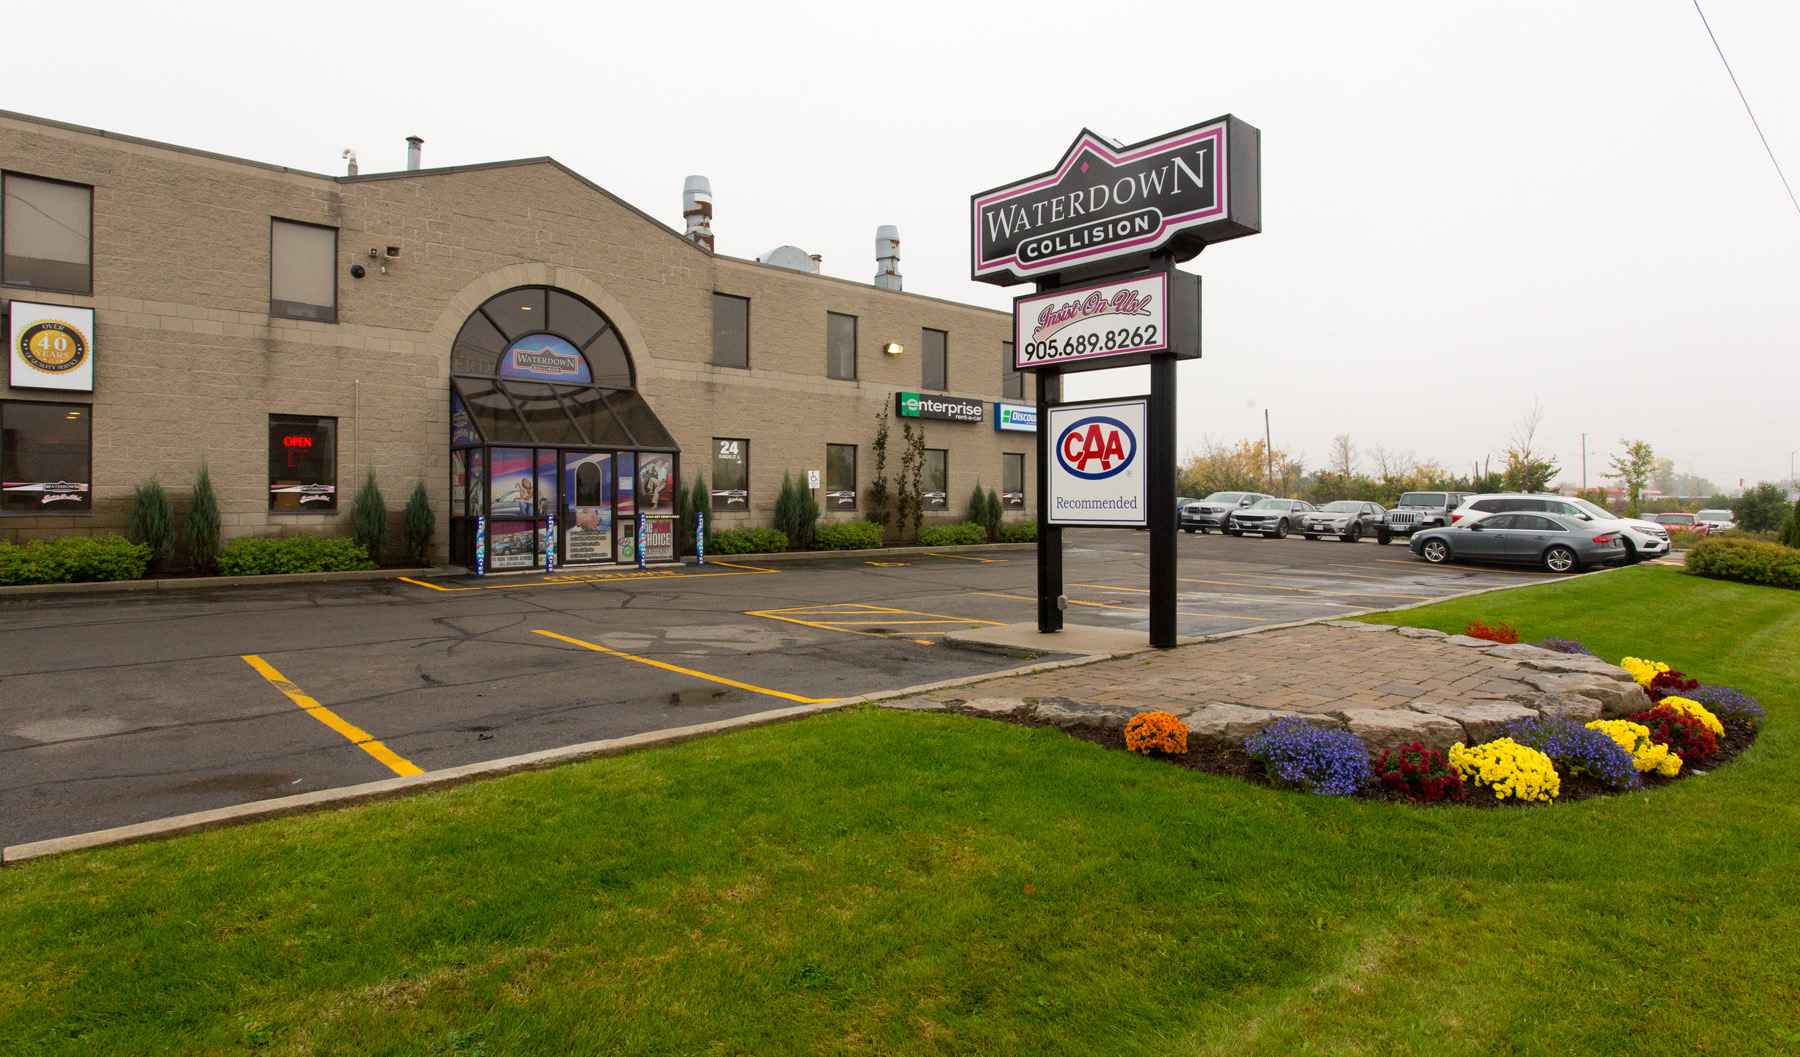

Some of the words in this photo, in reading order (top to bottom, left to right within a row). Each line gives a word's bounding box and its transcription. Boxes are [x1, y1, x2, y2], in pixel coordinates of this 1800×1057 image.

[986, 149, 1208, 243] WATERDOWN
[1026, 215, 1149, 258] COLLISION
[1035, 302, 1083, 332] Insist
[1081, 291, 1108, 316] On
[42, 323, 65, 331] OVER
[37, 336, 68, 352] 40
[1024, 324, 1157, 362] 905.689.8262
[35, 349, 69, 358] YEARS
[517, 353, 575, 368] WATERDOWN
[31, 358, 56, 370] QUALITY
[907, 398, 982, 416] enterprise
[1012, 412, 1037, 422] DISCOU
[283, 436, 312, 447] OPEN
[720, 440, 739, 454] 24
[1064, 424, 1125, 471] CAA
[1056, 496, 1137, 509] Recommended
[646, 533, 671, 546] HOICE
